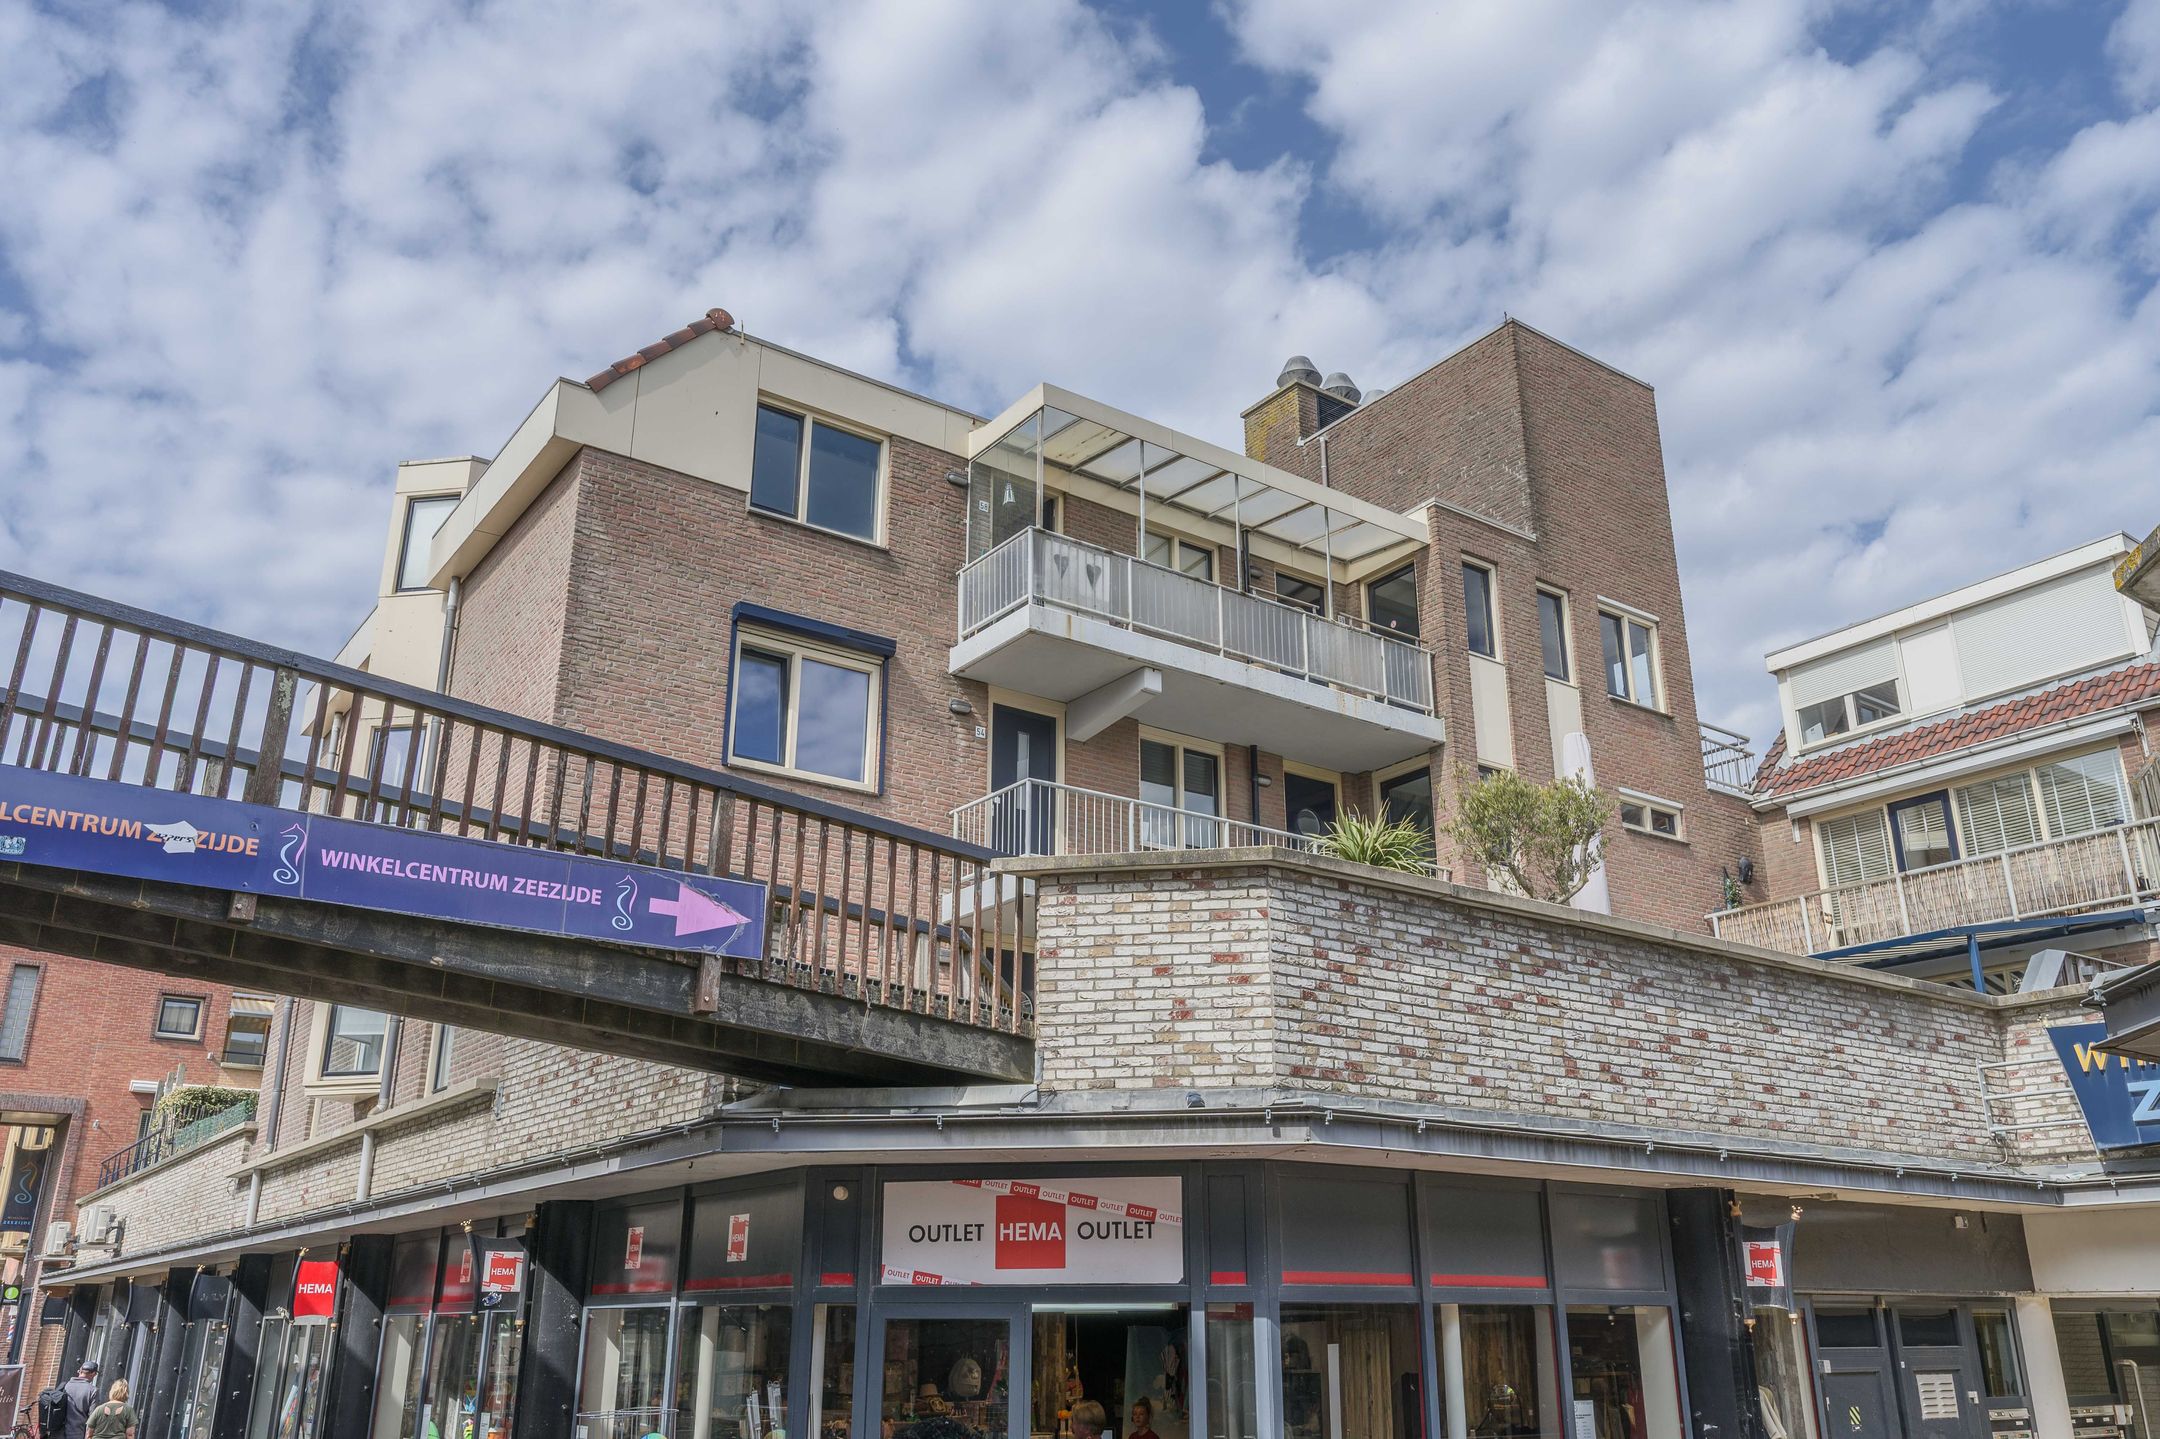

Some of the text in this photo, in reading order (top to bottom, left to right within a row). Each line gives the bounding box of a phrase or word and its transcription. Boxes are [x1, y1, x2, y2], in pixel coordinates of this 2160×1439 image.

[146, 826, 260, 856] ZZIJDE
[321, 848, 602, 906] WINKELCENTRUM ZEEZIJDE
[984, 1179, 1008, 1190] OUTLET
[1013, 1184, 1037, 1196] OUTLET
[1042, 1189, 1066, 1201] OUTLET
[1071, 1195, 1095, 1207] OUTLET
[1100, 1201, 1124, 1213] OUTLET
[1129, 1206, 1154, 1218] OUTLET
[1159, 1212, 1183, 1224] OUTLET
[908, 1220, 1156, 1243] OUTLET HEMA OUTLET
[491, 1267, 515, 1276] HEMA
[1751, 1259, 1775, 1269] HEMA
[887, 1269, 911, 1280] OUTLET
[915, 1274, 940, 1285] OUTLET
[297, 1282, 334, 1296] HEMA
